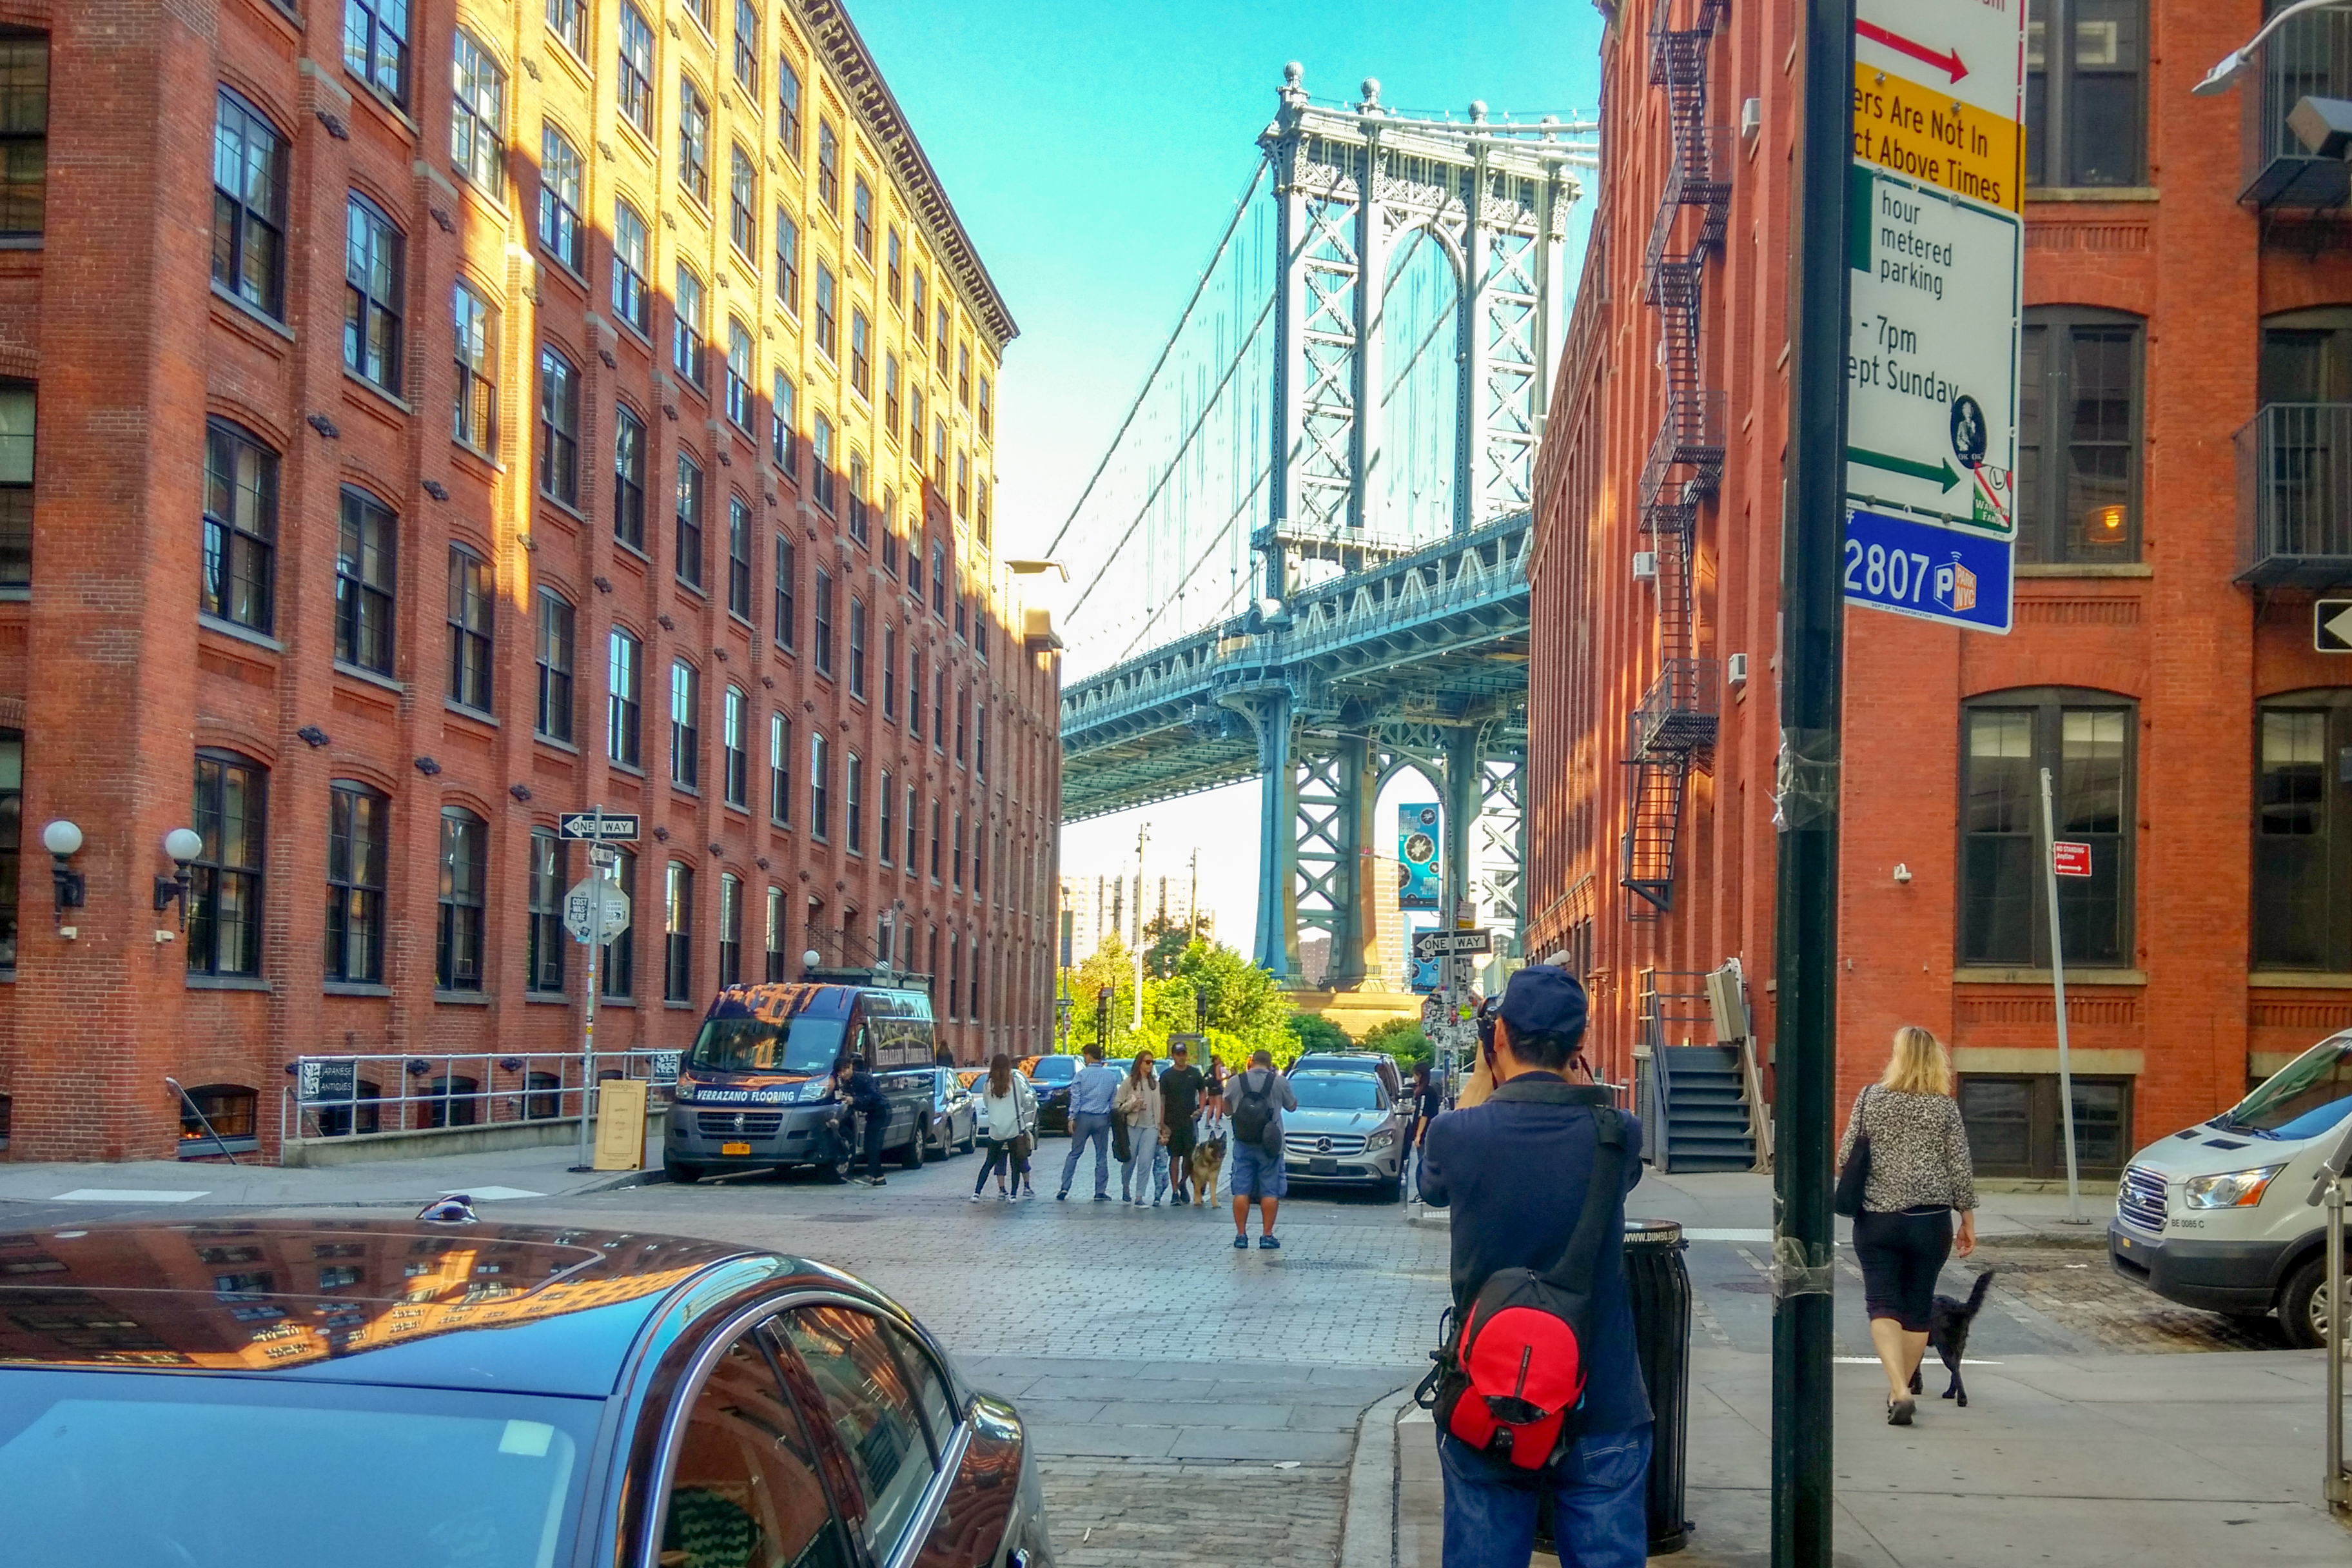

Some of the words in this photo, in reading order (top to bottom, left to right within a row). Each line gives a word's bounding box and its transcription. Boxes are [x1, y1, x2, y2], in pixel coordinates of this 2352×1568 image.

[1890, 96, 1923, 133] Are
[1931, 110, 1964, 150] Not
[1972, 125, 1988, 158] In
[1879, 135, 1939, 182] Above
[1947, 159, 2000, 204] Times
[1883, 190, 1921, 225] hour
[1882, 227, 1952, 267] metered
[1881, 259, 1943, 301] parking
[1877, 315, 1916, 355] 7pm
[1887, 360, 1959, 407] Sunday
[1983, 511, 2000, 524] FANS
[1957, 567, 1974, 589] PARK
[1956, 586, 1974, 607] NYC
[1892, 607, 1932, 619] TRANSPORTATION
[573, 821, 594, 831] ONE
[605, 823, 629, 832] WAY
[603, 851, 612, 861] WAY
[571, 912, 585, 921] HERE
[1425, 939, 1447, 950] ONE
[1457, 937, 1480, 948] WAY
[319, 1067, 352, 1079] JAPANESE
[320, 1082, 352, 1092] ANTIQUES
[697, 1090, 748, 1101] VERRAZANO
[751, 1091, 794, 1102] FLOORING
[2199, 1220, 2204, 1228] C
